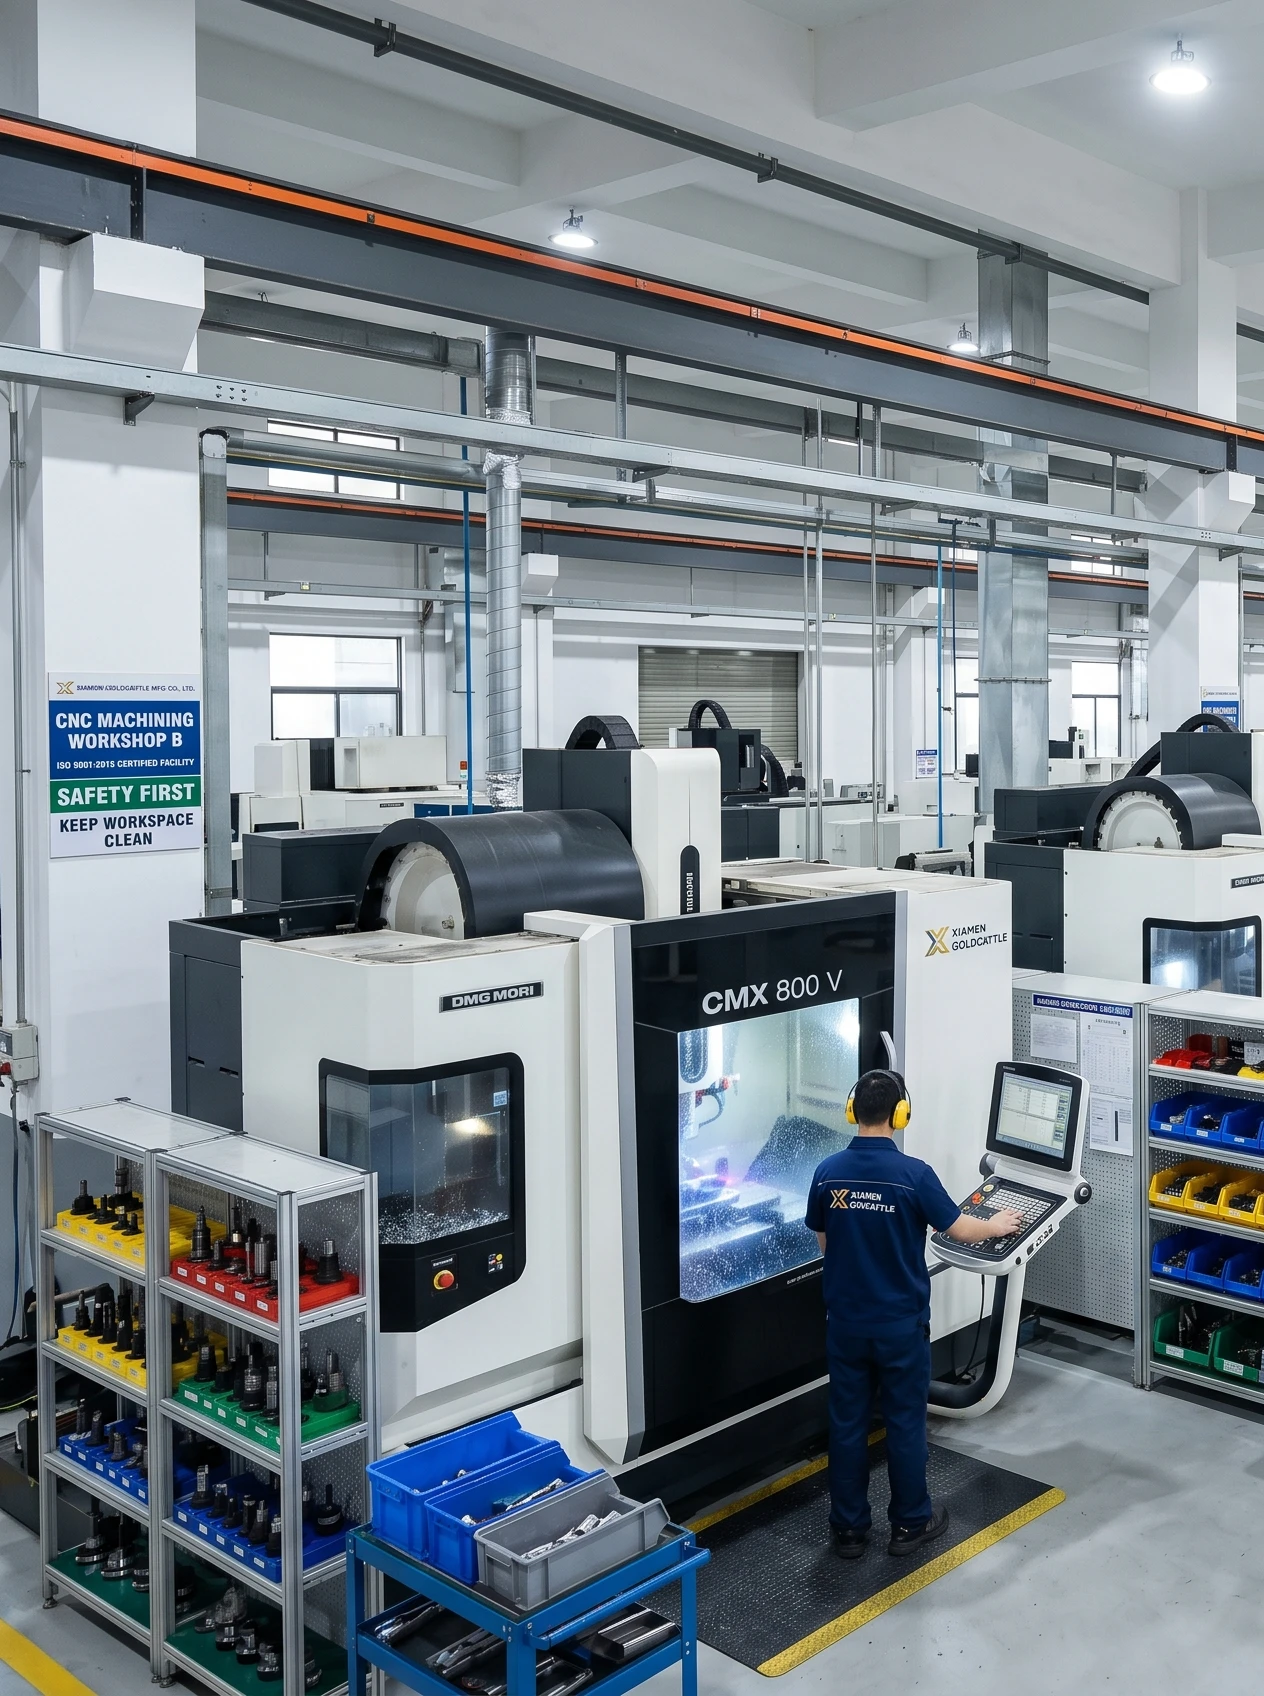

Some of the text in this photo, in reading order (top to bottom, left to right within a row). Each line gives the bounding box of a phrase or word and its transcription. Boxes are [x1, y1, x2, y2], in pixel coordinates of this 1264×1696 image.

[55, 712, 194, 729] CNC MACHINING
[68, 732, 183, 749] WORKSHOP B
[117, 759, 158, 768] CERTIFIED
[160, 758, 194, 767] FACILITY
[57, 783, 195, 806] SAFETY FIRST
[60, 813, 194, 832] KEEP WORKSPACE
[104, 832, 153, 847] CLEAN
[952, 924, 986, 937] XIAMEN
[952, 933, 1008, 951] GOLDCATTLE
[452, 985, 534, 1007] DMG MORI
[702, 969, 843, 1015] CMX 800 V
